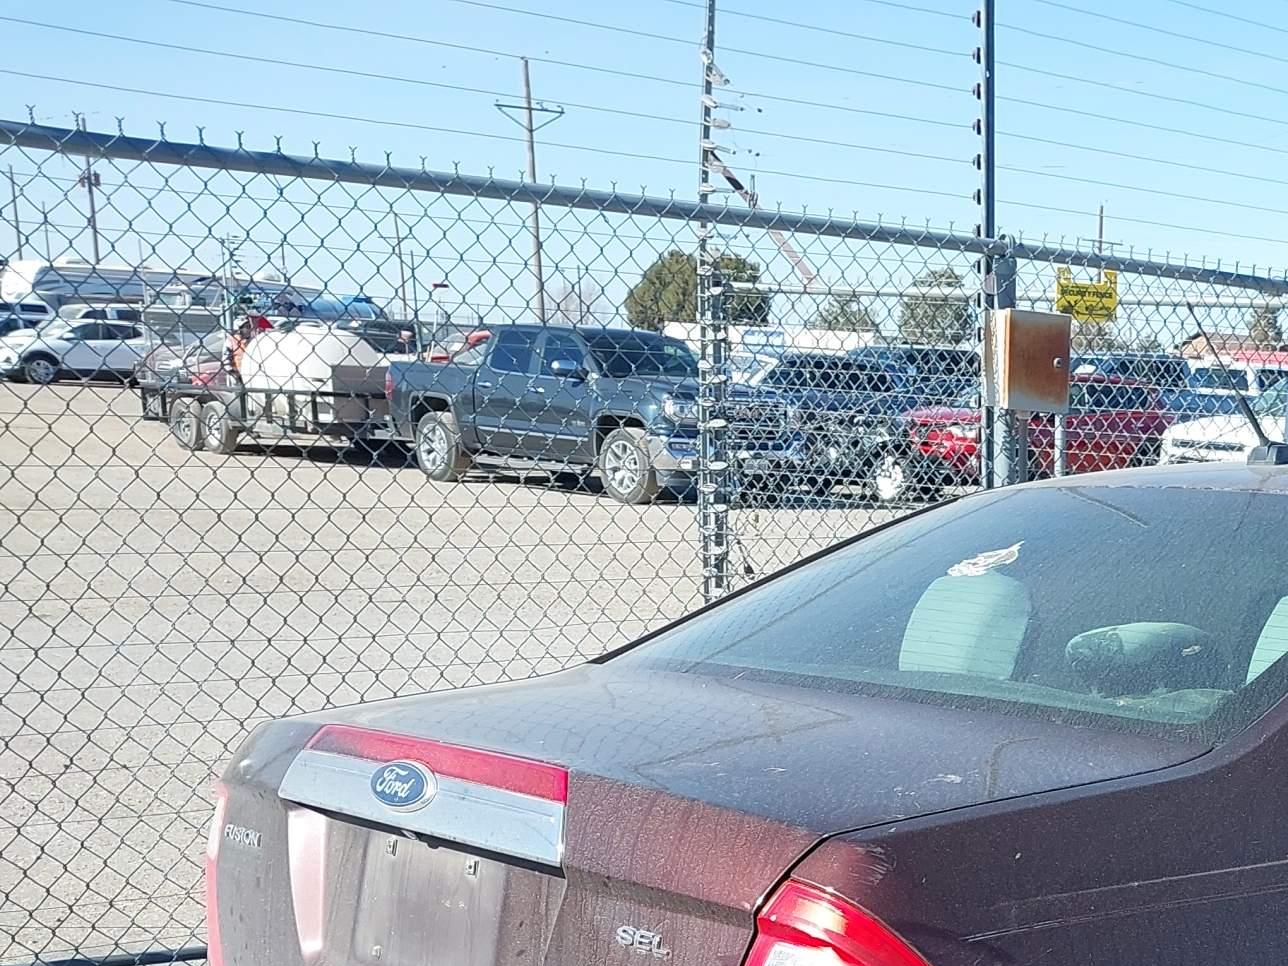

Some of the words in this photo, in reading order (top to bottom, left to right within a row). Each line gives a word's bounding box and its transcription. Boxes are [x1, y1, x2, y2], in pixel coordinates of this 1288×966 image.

[376, 766, 416, 798] Ford
[224, 824, 263, 848] FUSION
[616, 925, 673, 960] SEL
